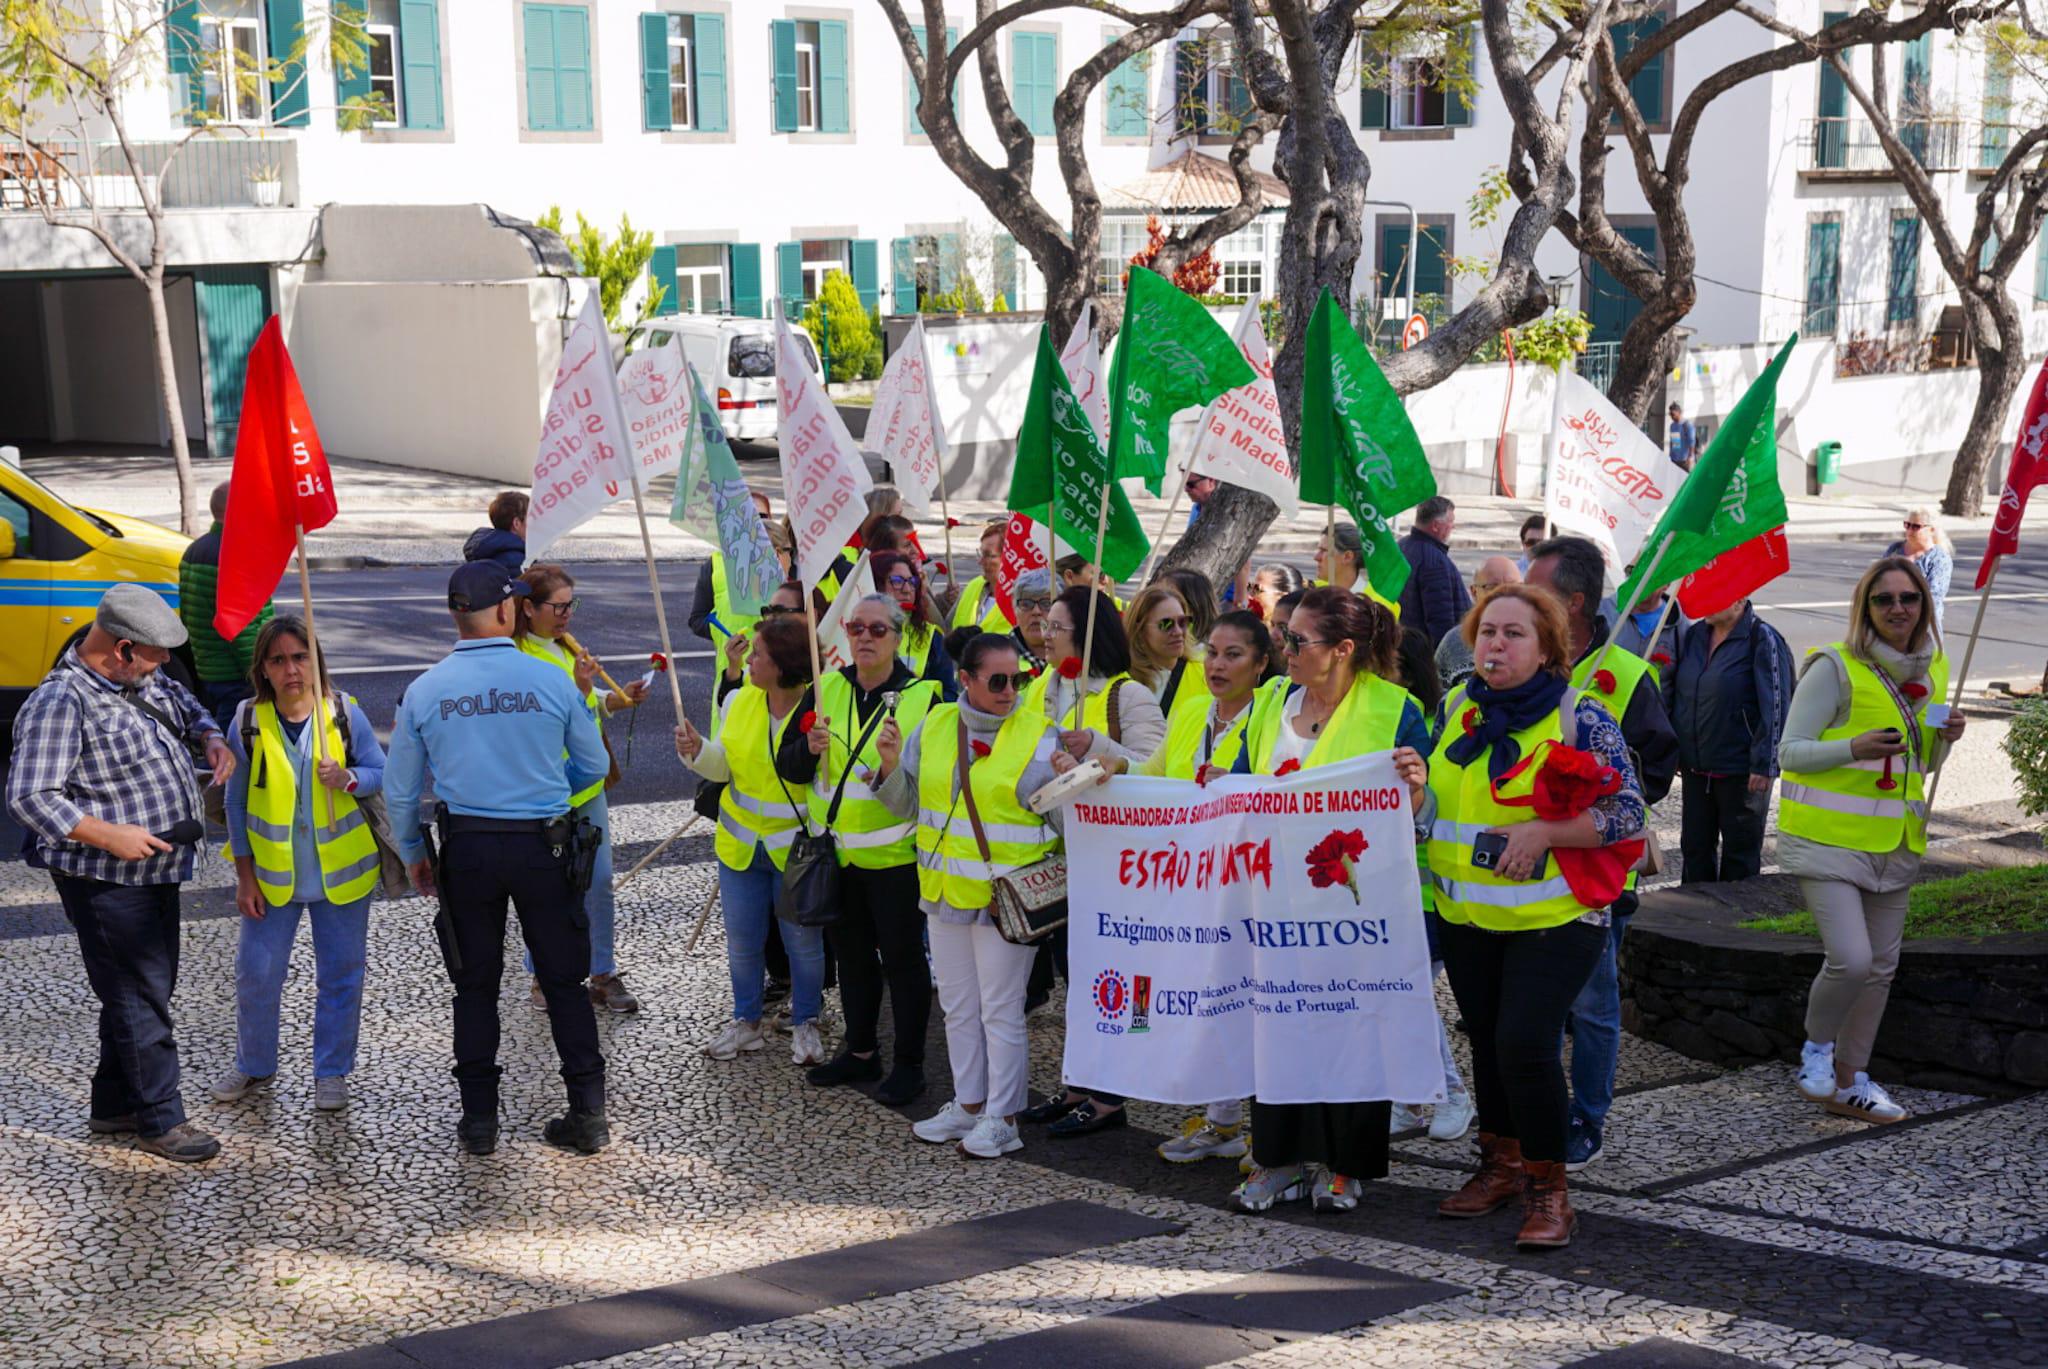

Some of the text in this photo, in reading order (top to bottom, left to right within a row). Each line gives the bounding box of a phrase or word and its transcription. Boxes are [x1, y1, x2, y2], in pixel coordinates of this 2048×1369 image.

[1234, 384, 1282, 418] nião
[1216, 392, 1286, 447] Sindica
[1601, 456, 1664, 501] CGTP
[440, 688, 543, 720] POLÍCIA
[1074, 803, 1174, 827] TRABALHADORAS
[1174, 806, 1190, 825] DA
[1303, 791, 1324, 813] DE
[1327, 787, 1400, 813] MACHICO
[1021, 863, 1067, 889] TOUS
[1119, 840, 1191, 894] ESTÃO
[1097, 912, 1174, 946] Exigimos
[1177, 926, 1191, 943] os
[1156, 989, 1198, 1016] CESP
[1327, 979, 1346, 993] do
[1347, 978, 1414, 992] Comércio
[1275, 1001, 1292, 1014] de
[1296, 997, 1360, 1014] Portugal.
[1096, 1021, 1124, 1035] CESP
